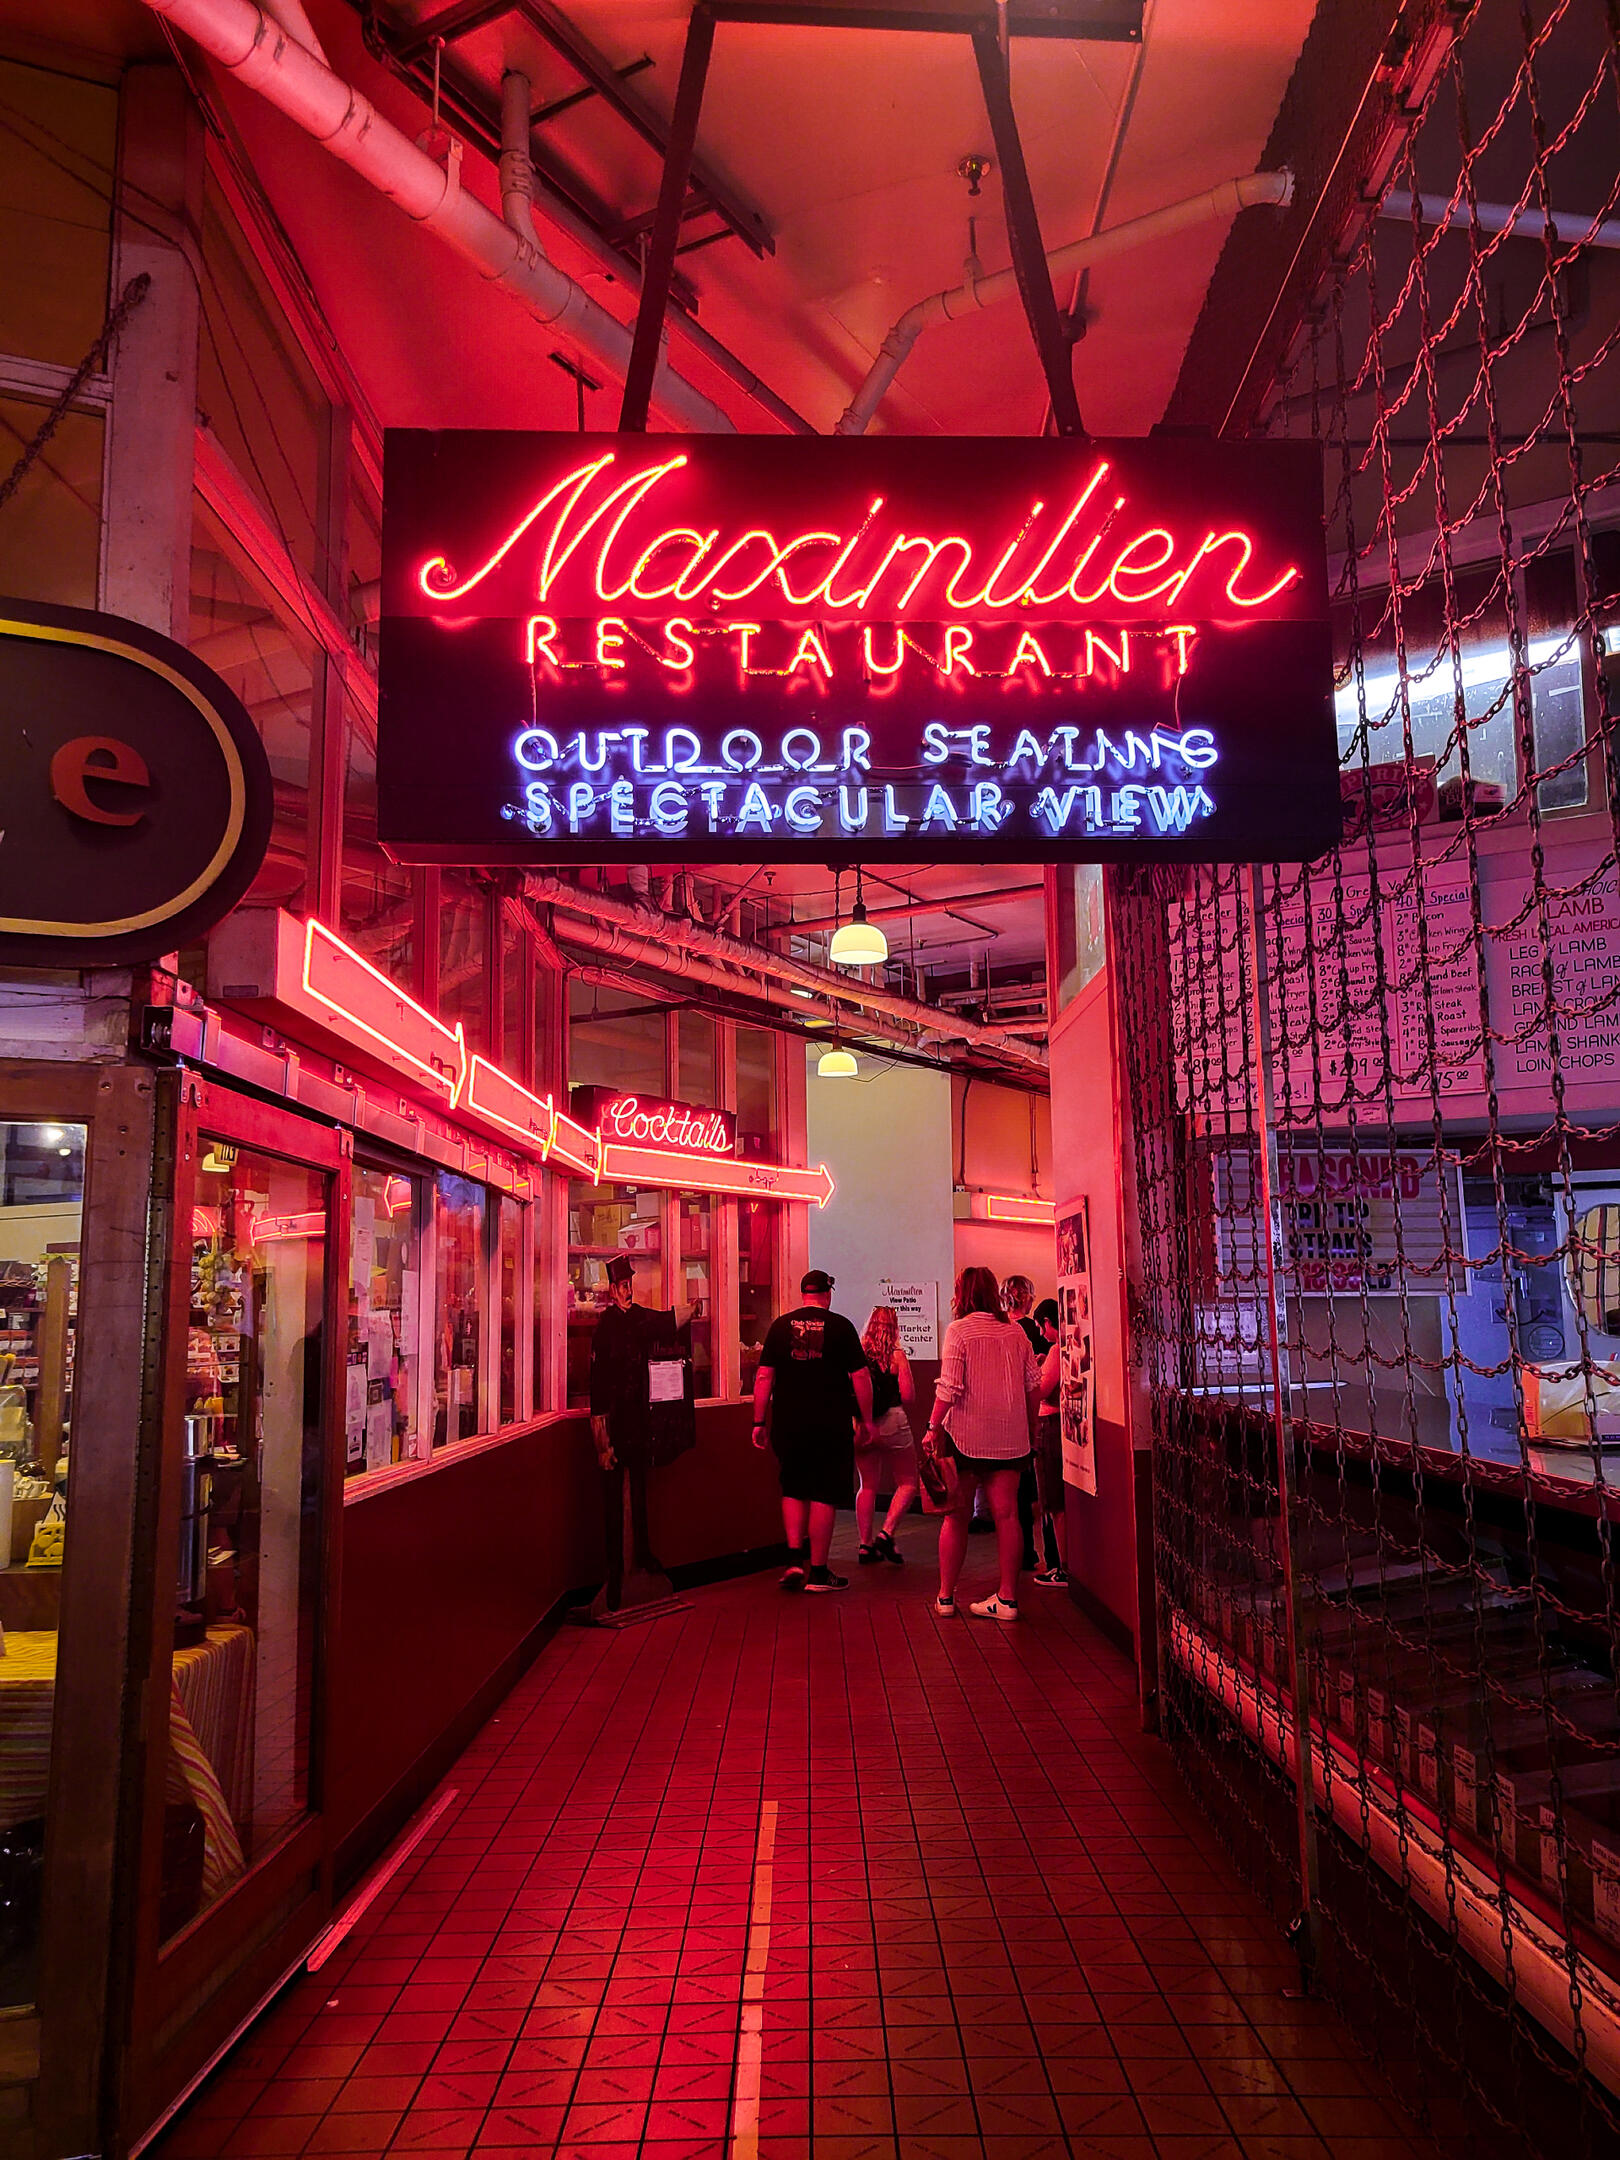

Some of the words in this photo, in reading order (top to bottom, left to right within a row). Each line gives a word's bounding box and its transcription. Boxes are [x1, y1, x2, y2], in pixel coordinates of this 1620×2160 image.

[417, 451, 1300, 610] Maximilien
[524, 615, 1198, 677] RESTAURANT
[513, 726, 872, 773] OUTDOOR
[923, 721, 1220, 771] SEATING
[52, 736, 150, 827] e
[524, 780, 1010, 833] SPECTACULAR
[1041, 784, 1214, 833] VIEW
[1546, 897, 1605, 919] LAMB
[1509, 945, 1539, 961] LEG
[1559, 937, 1608, 955] LAMB
[1510, 963, 1542, 980] RAC
[1434, 999, 1463, 1010] Steak
[1437, 1011, 1467, 1022] Roast
[1516, 1058, 1552, 1073] LOIN
[1559, 1052, 1616, 1070] CHOPS
[610, 1096, 734, 1153] Cocktails
[903, 1334, 933, 1343] Center
